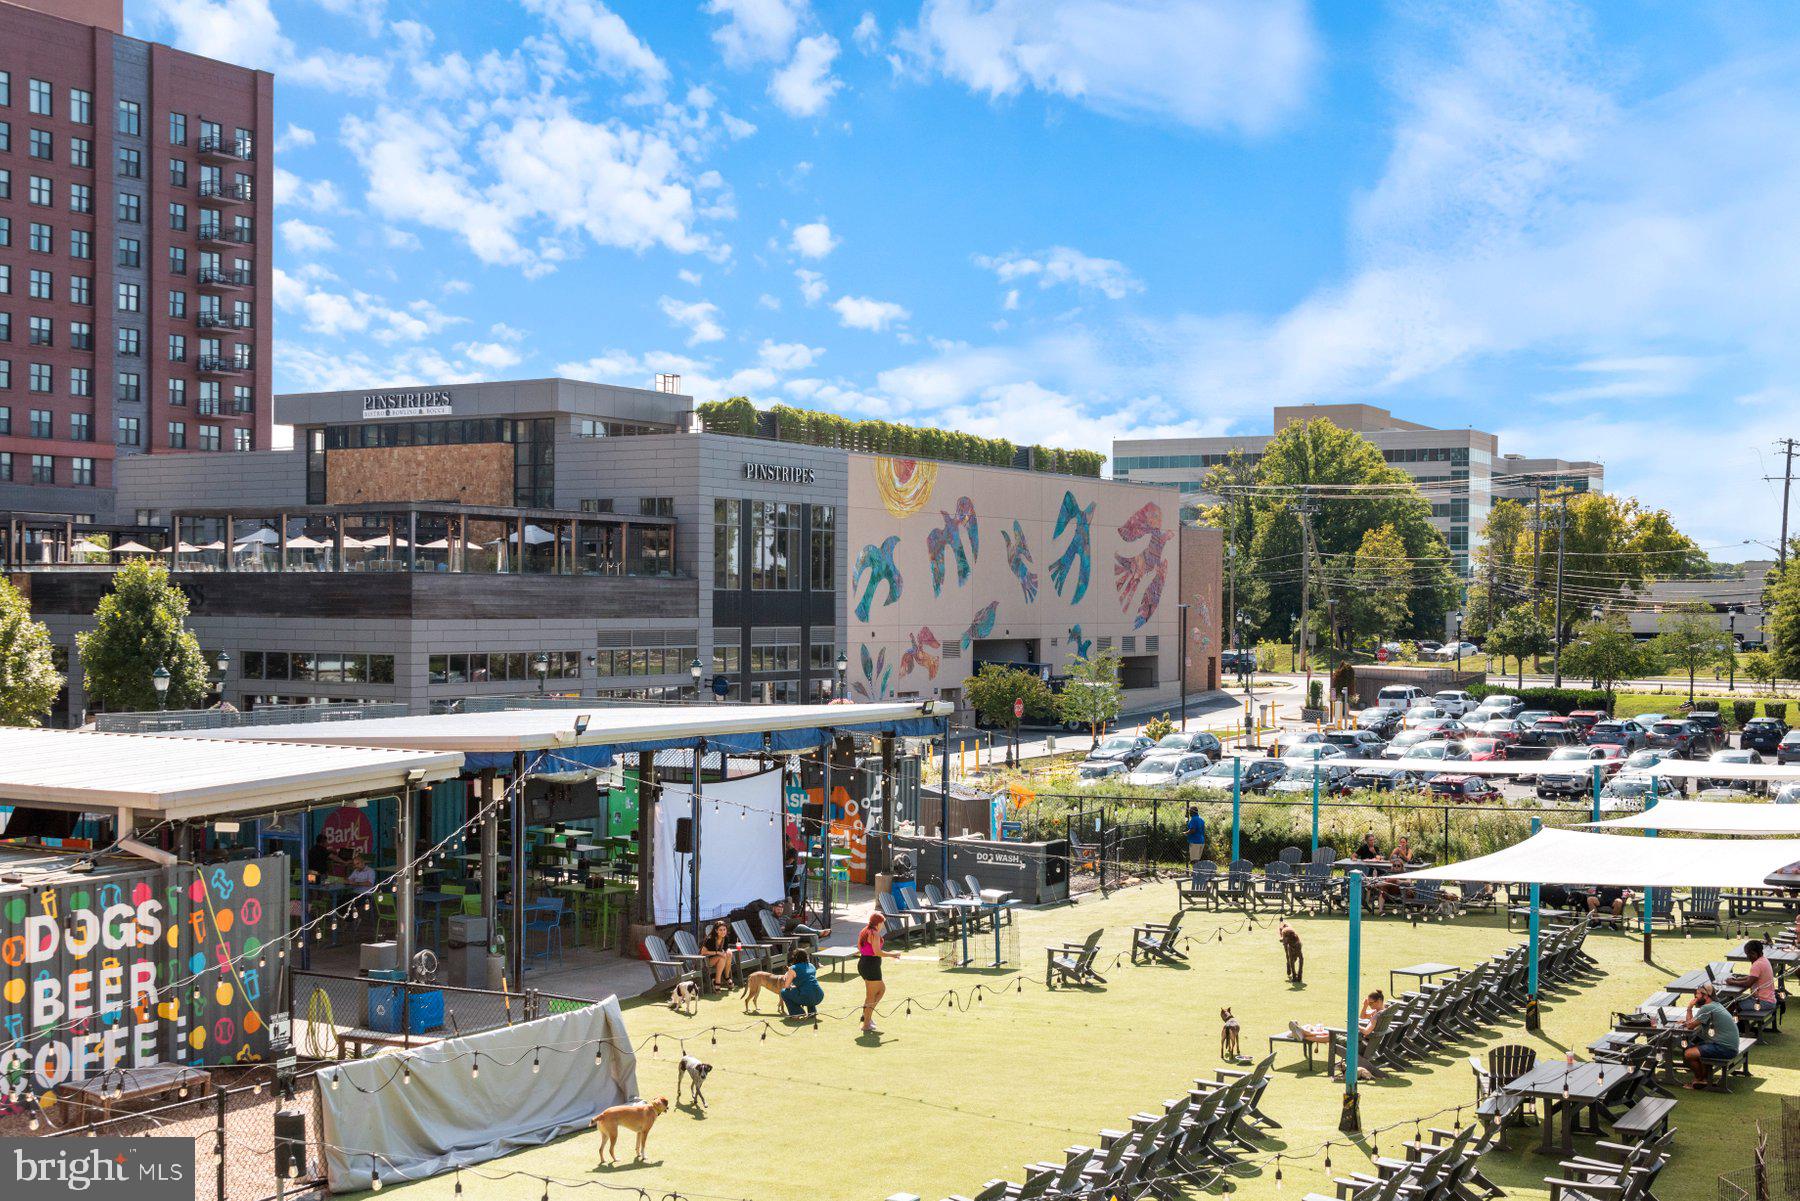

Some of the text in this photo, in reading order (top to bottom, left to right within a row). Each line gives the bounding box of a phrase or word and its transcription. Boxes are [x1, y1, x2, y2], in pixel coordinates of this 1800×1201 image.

[363, 391, 451, 410] PINSTRIPES
[746, 462, 816, 484] PINSTRIPES
[325, 822, 358, 843] Bark
[995, 854, 1019, 863] WASH
[25, 899, 163, 963] DOGS
[33, 961, 159, 1027] BEER
